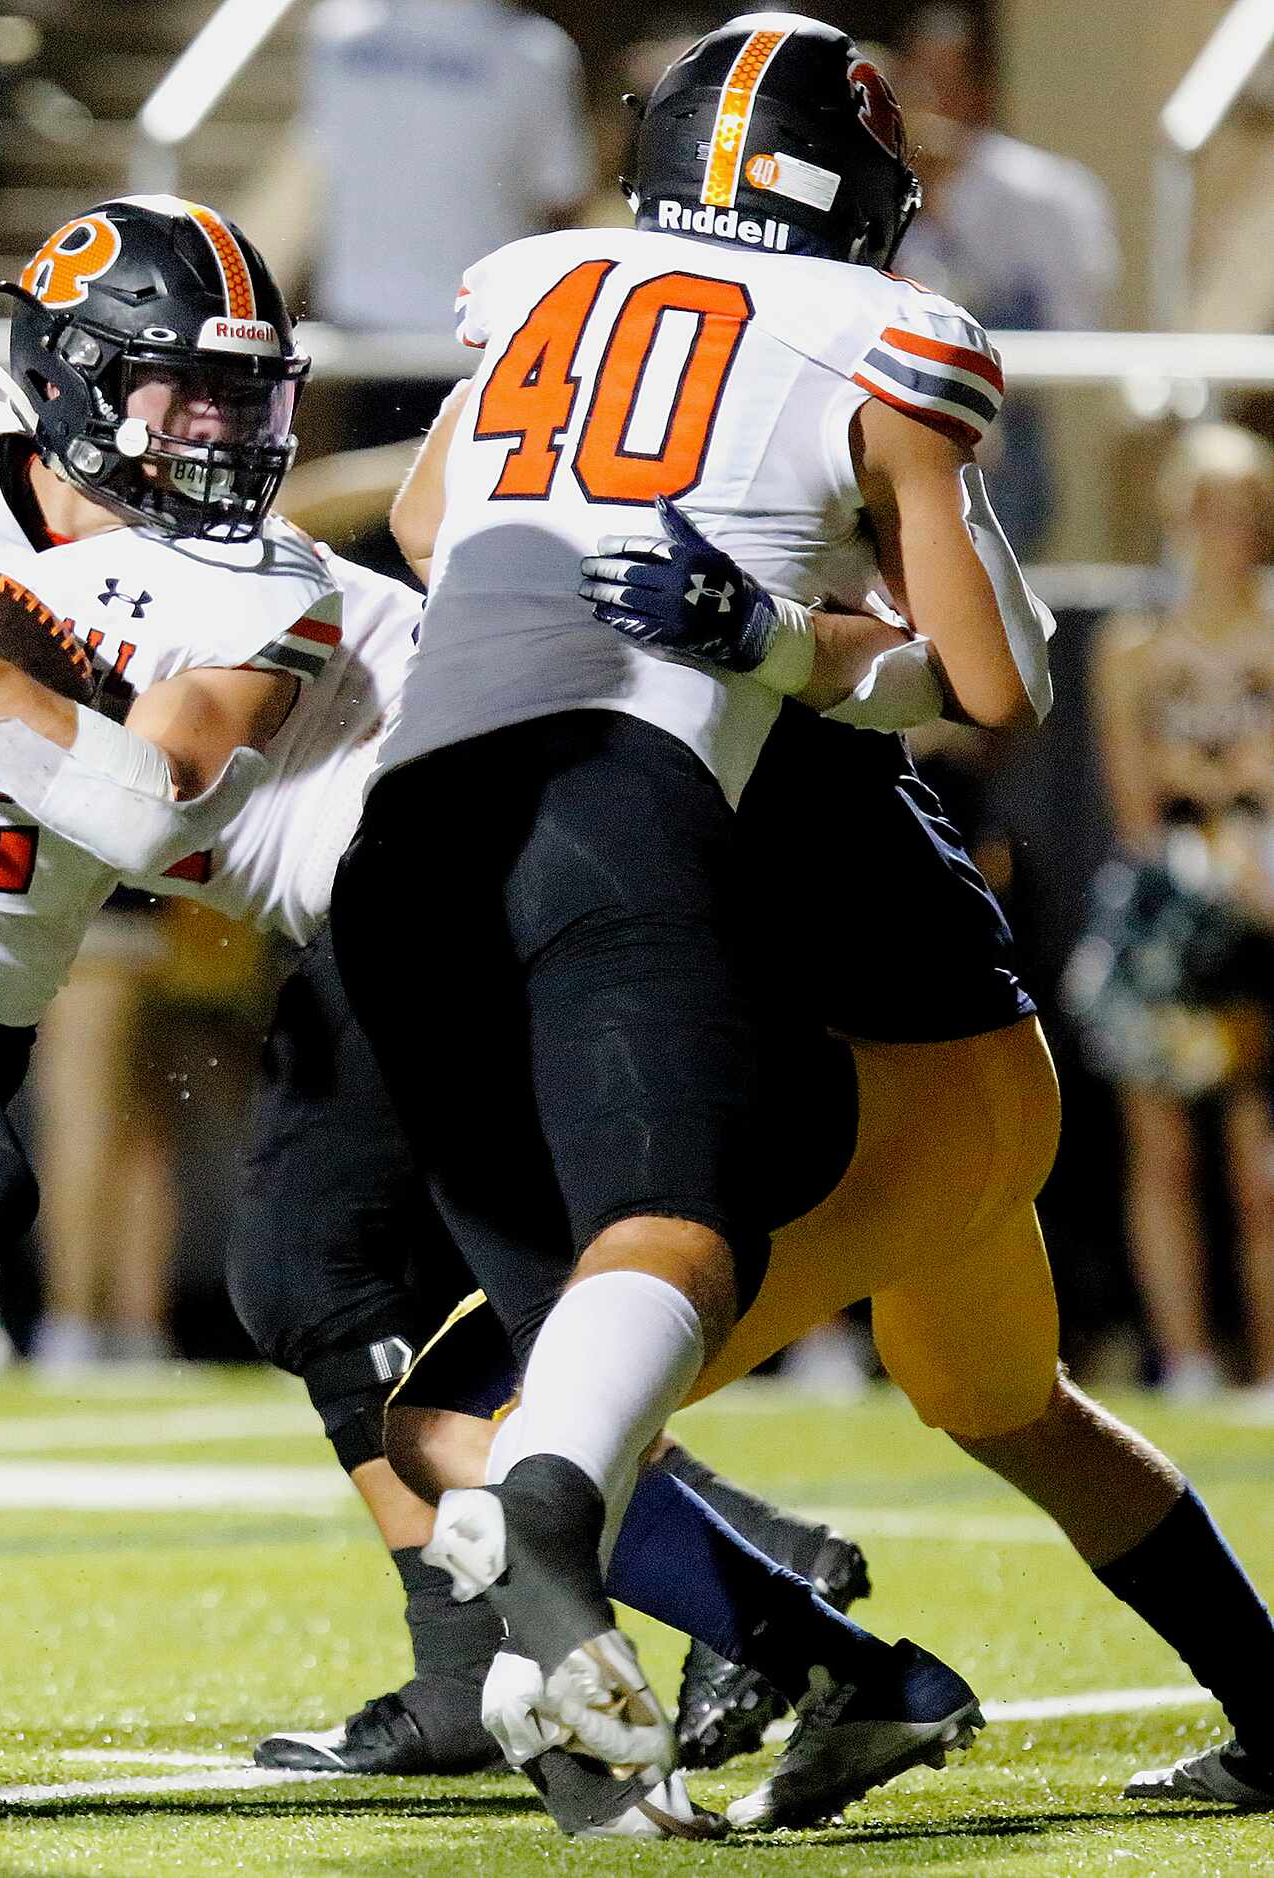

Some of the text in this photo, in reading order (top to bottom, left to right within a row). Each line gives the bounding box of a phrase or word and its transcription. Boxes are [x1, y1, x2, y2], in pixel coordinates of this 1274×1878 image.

[751, 157, 776, 185] 40
[657, 199, 790, 251] Riddell
[216, 321, 274, 342] Riddell
[472, 258, 756, 504] 40
